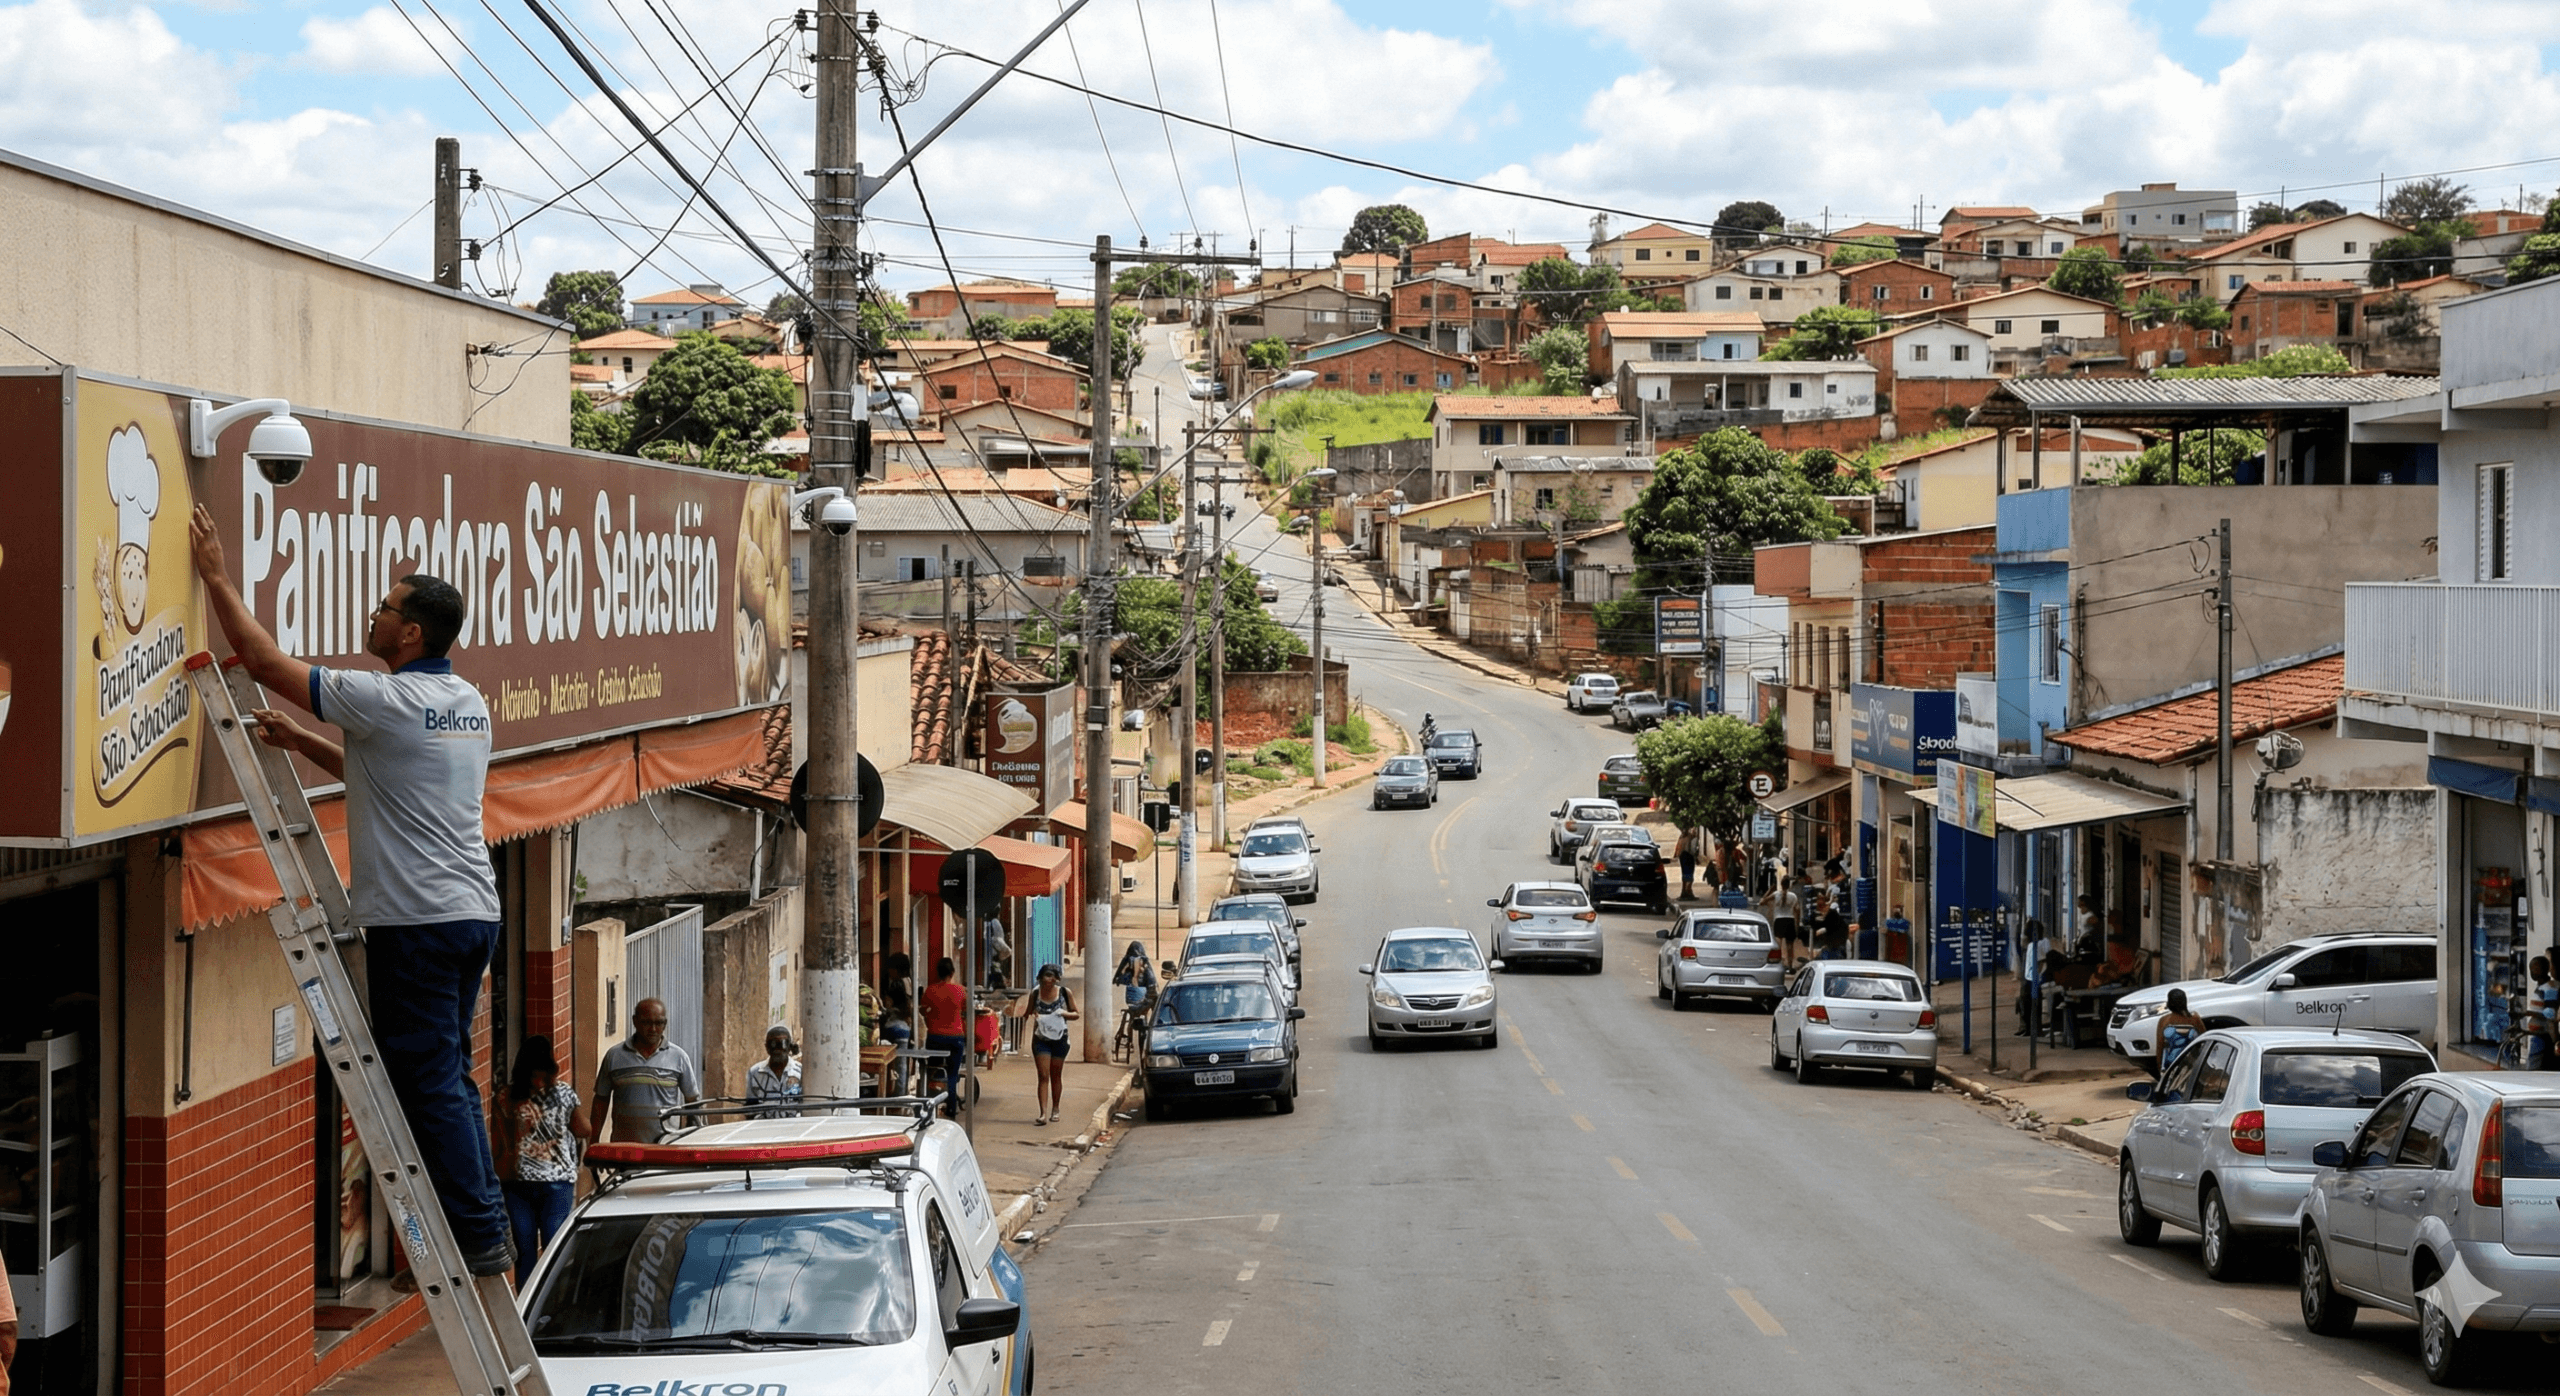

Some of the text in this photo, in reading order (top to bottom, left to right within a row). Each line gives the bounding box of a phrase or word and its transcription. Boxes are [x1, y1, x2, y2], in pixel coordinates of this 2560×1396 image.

[524, 481, 583, 645] São
[593, 489, 718, 640] Sebastião
[100, 626, 184, 717] Panificadora
[425, 708, 490, 731] Belkron
[101, 678, 190, 785] São Sebastião
[1755, 778, 1768, 792] E
[2296, 1001, 2347, 1014] Belkron
[586, 1380, 788, 1396] Belkron
